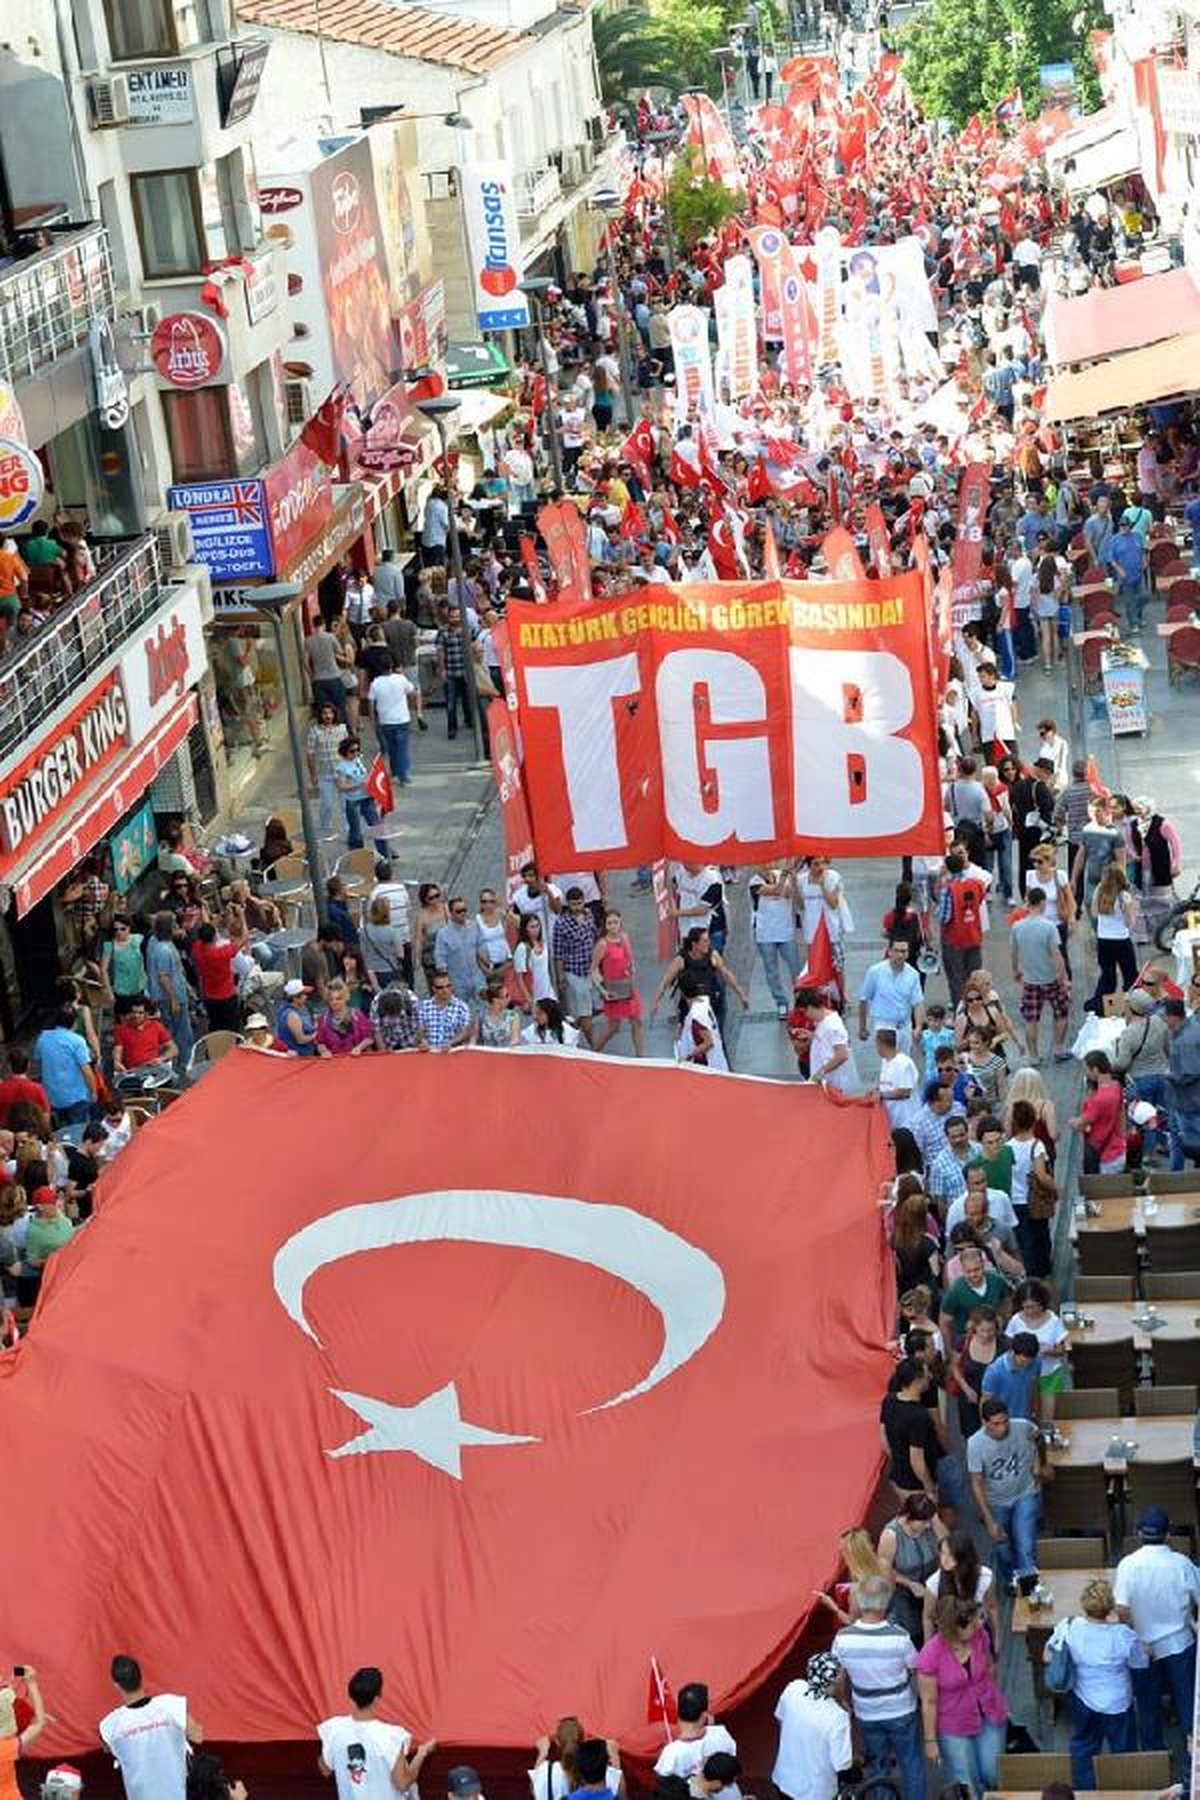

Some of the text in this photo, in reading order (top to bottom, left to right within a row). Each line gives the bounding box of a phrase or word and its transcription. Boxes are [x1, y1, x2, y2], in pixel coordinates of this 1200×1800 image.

[174, 489, 232, 507] LONDRA
[519, 611, 620, 648] ATATÜRK
[794, 597, 904, 636] BAŞINDA!
[3, 685, 127, 852] BURGER KING
[523, 647, 925, 853] TGB
